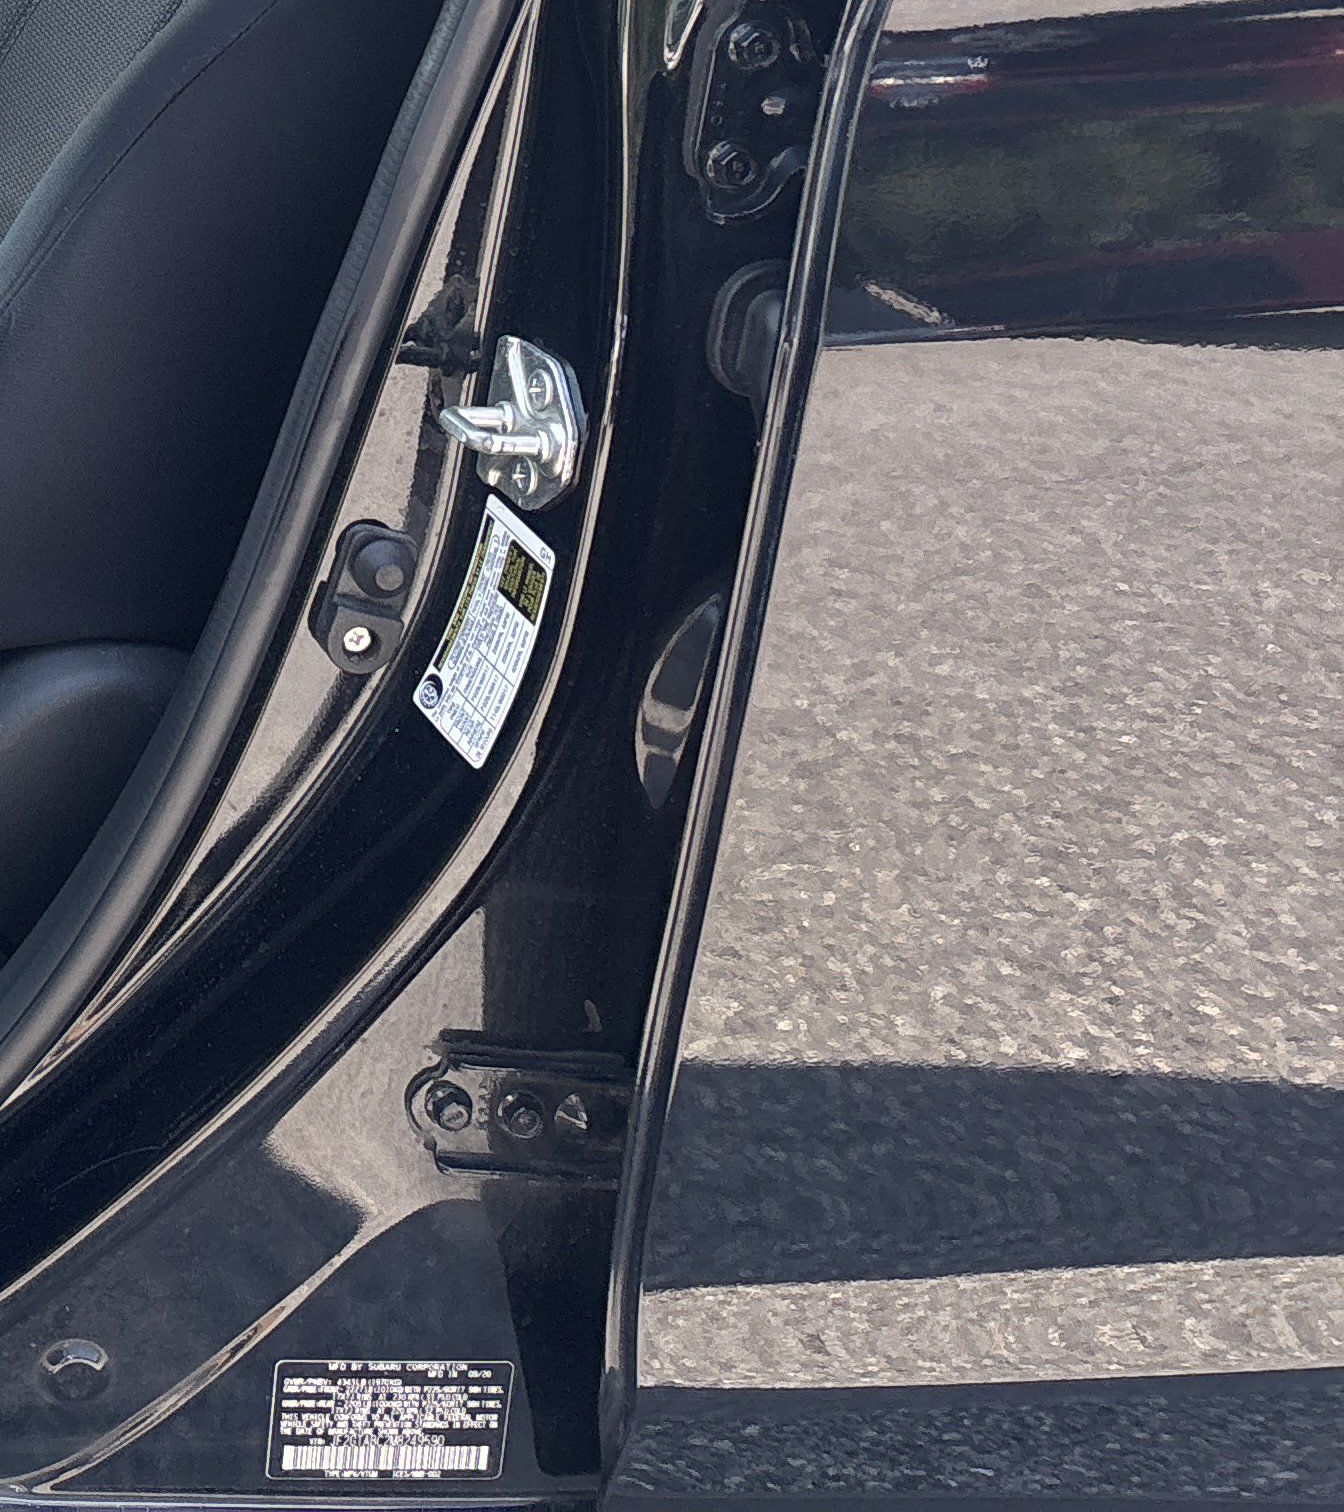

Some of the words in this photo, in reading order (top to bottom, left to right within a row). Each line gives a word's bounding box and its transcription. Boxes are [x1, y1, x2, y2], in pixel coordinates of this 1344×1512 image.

[351, 1363, 362, 1371] BY
[368, 1363, 401, 1371] SUBARU
[406, 1363, 468, 1371] CORPORATION
